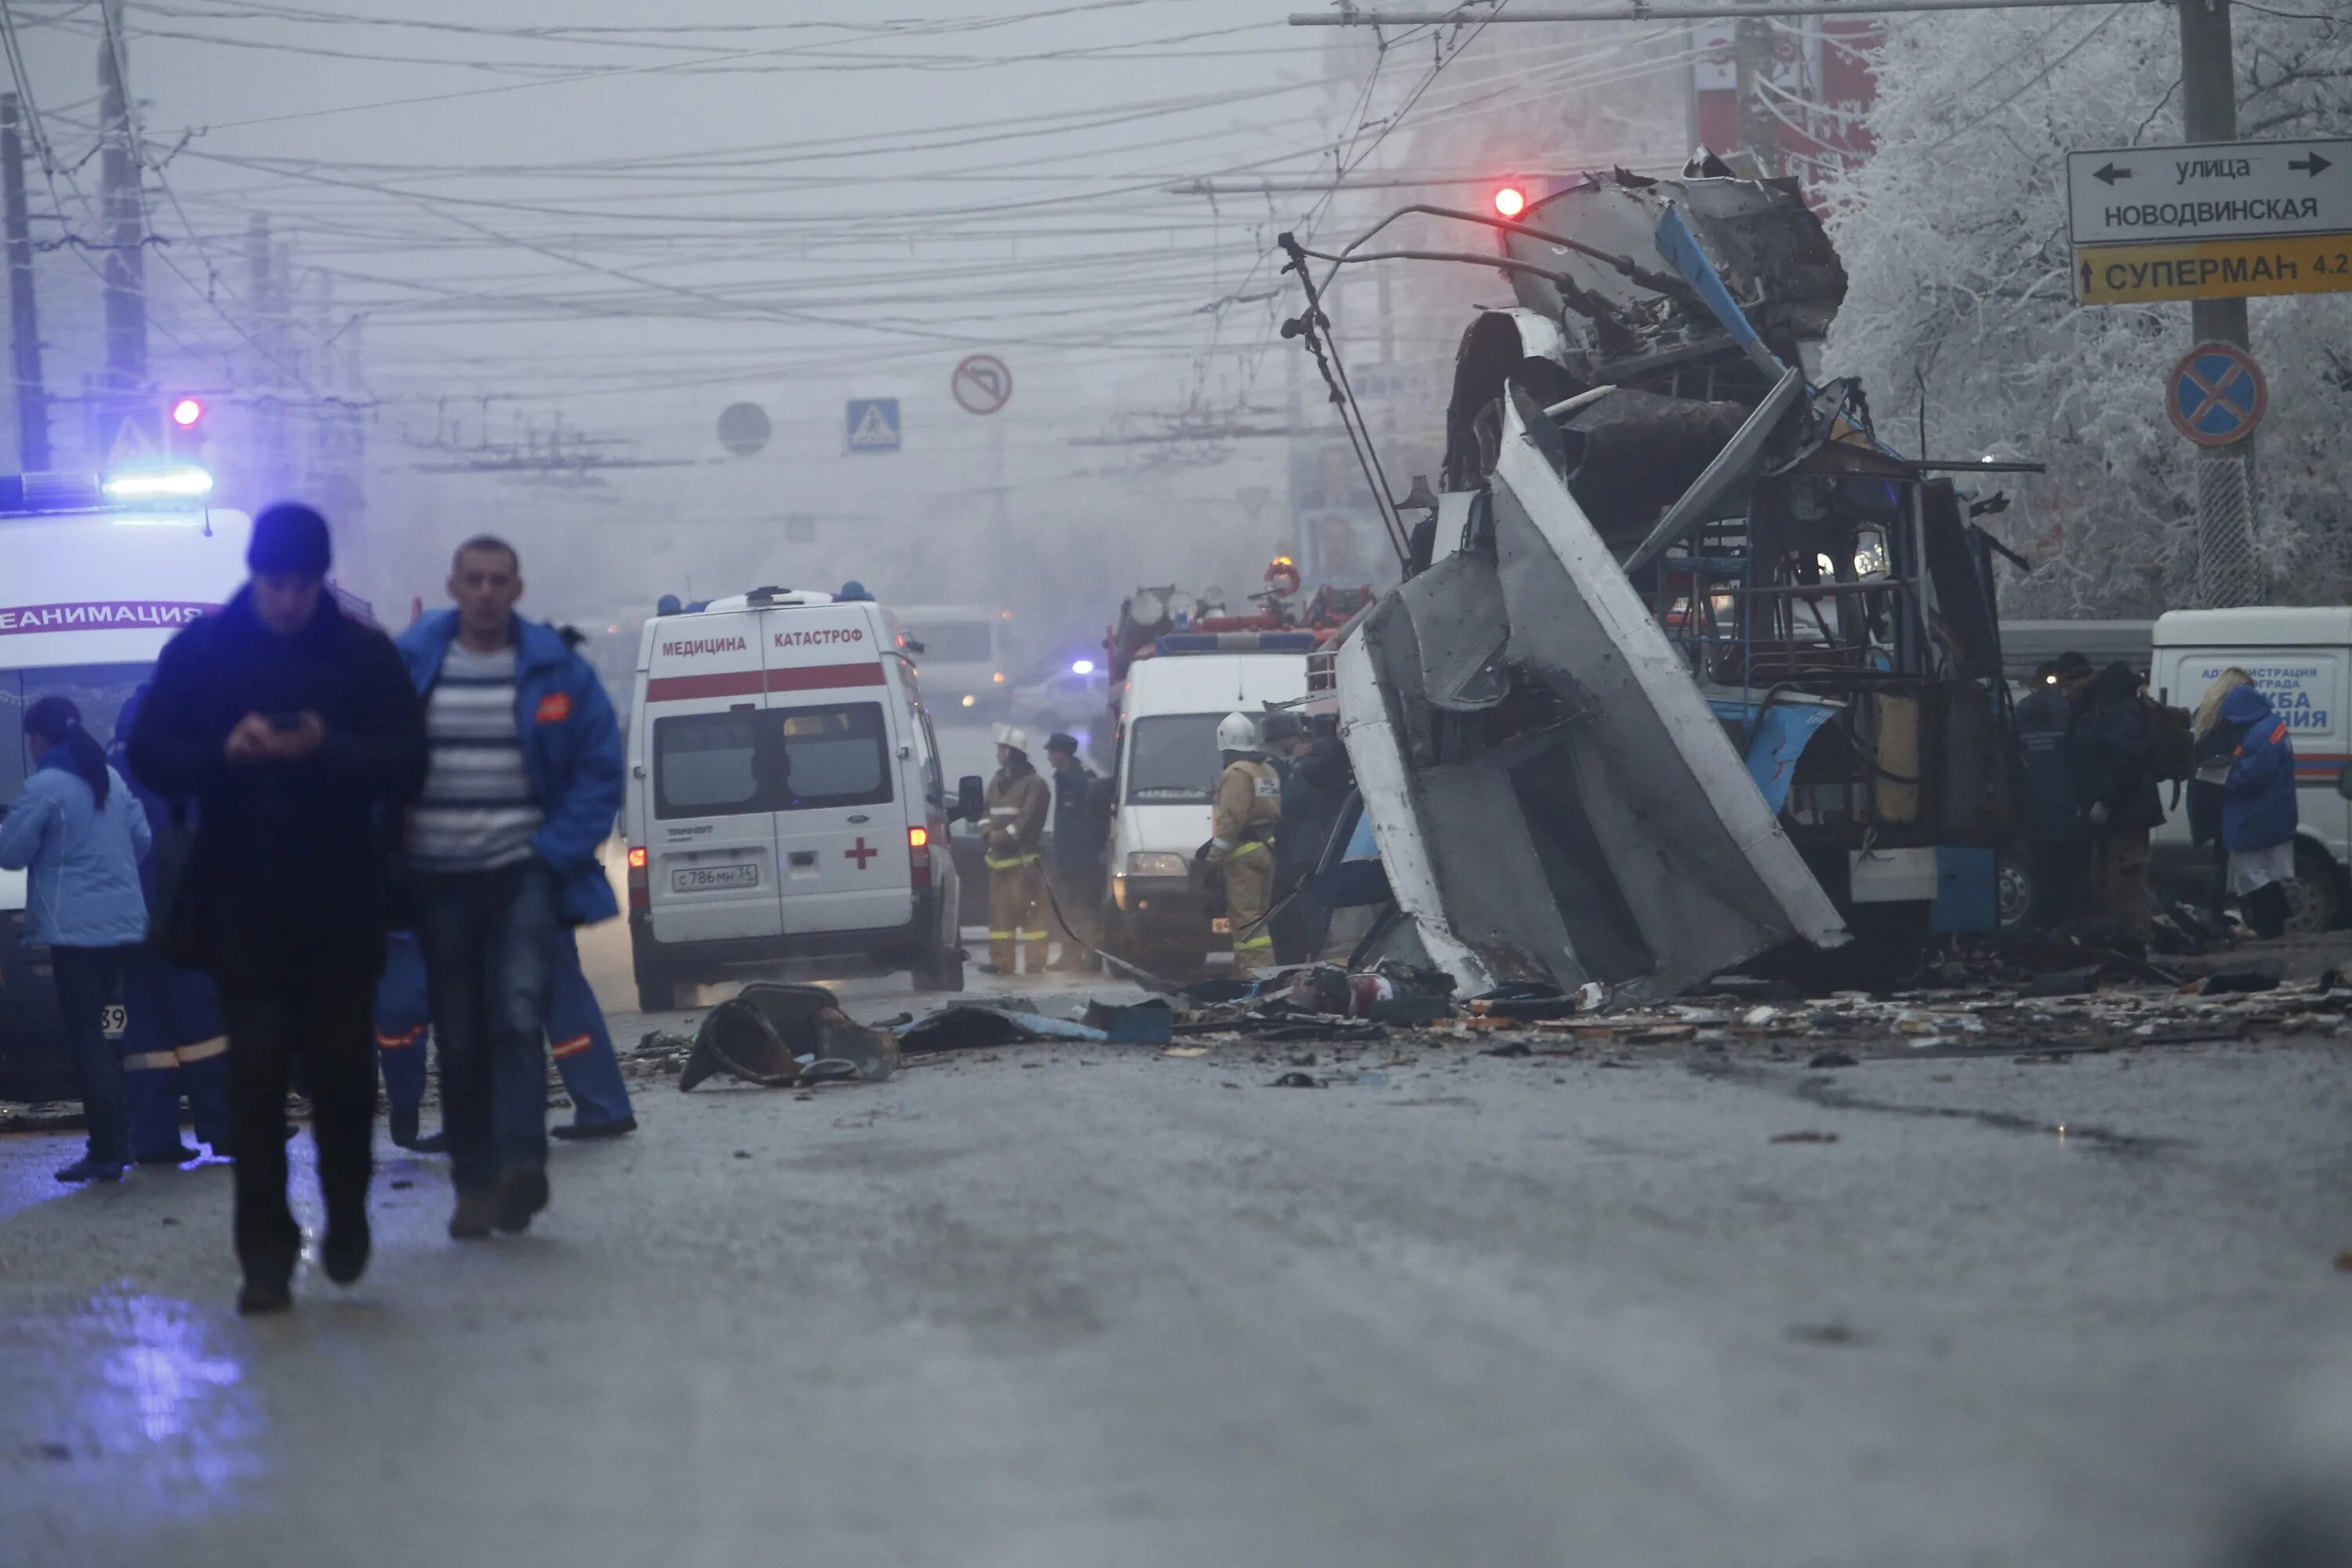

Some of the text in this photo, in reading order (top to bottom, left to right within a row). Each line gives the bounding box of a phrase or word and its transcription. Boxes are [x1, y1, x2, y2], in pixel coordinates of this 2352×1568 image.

[2176, 158, 2251, 185] улица
[2104, 198, 2318, 227] НОВОДВИНСКАЯ
[2105, 254, 2298, 291] СУПЕРМАН
[662, 629, 862, 657] МЕДИЦИНА КАТАСТРОФ
